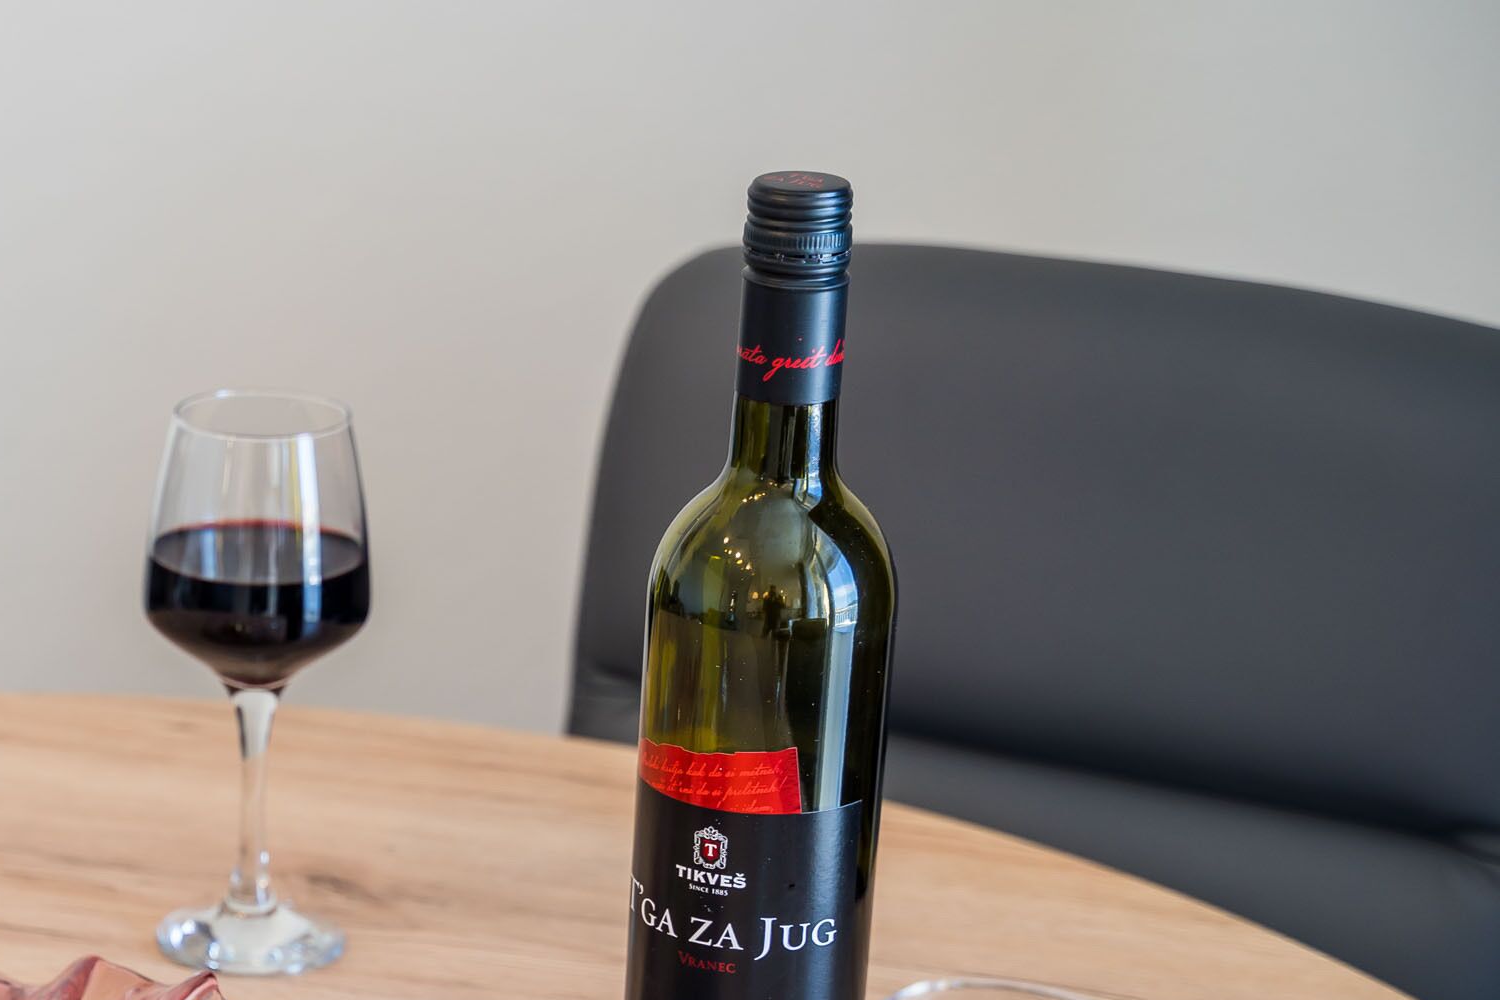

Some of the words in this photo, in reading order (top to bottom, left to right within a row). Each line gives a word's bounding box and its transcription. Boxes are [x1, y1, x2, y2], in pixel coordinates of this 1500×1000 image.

[704, 843, 717, 857] T
[675, 863, 747, 889] TIKVEŠ
[688, 883, 709, 894] SINCE
[711, 888, 729, 897] 1885
[688, 916, 744, 951] ZA
[753, 917, 838, 961] JUG
[677, 950, 737, 974] VRANEC
